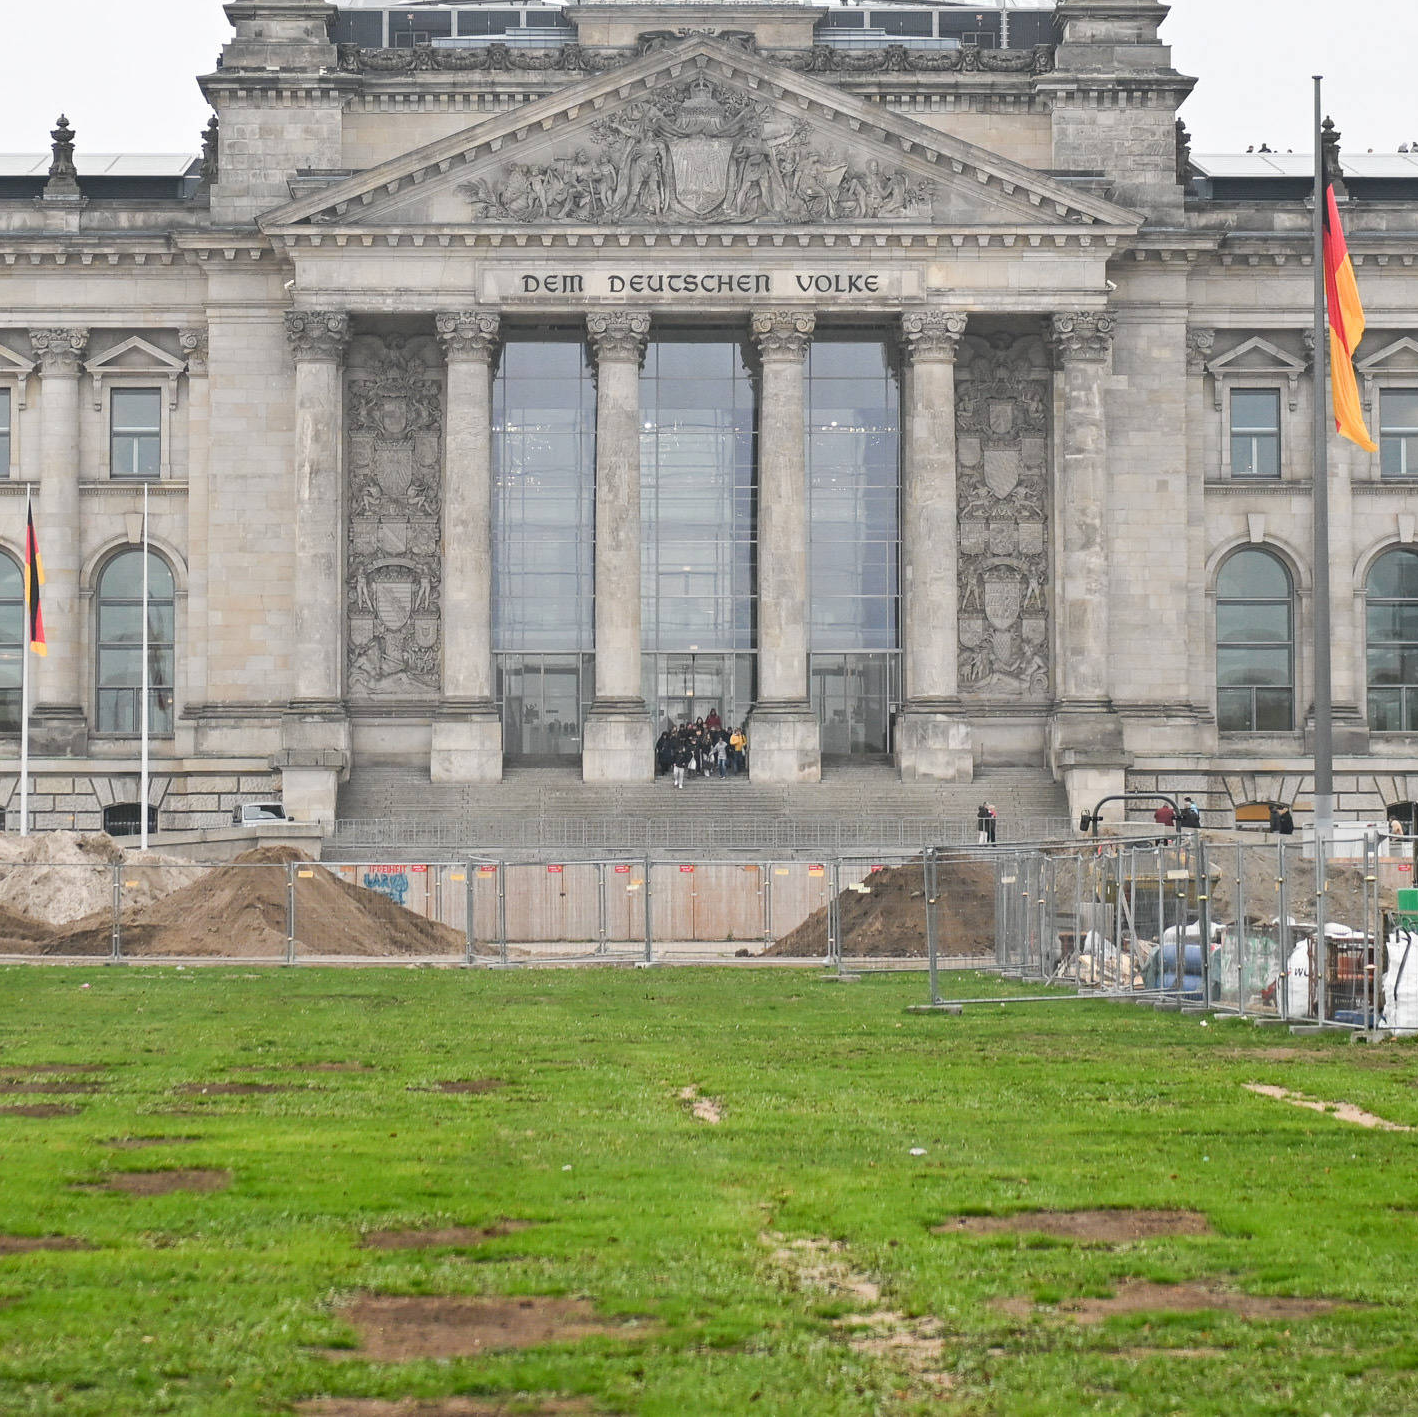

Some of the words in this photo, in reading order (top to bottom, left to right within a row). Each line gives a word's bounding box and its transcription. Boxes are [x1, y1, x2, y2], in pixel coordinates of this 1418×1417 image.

[521, 274, 583, 293] DEM
[608, 274, 771, 293] DEUTSCHEN
[796, 274, 879, 293] VOLKE
